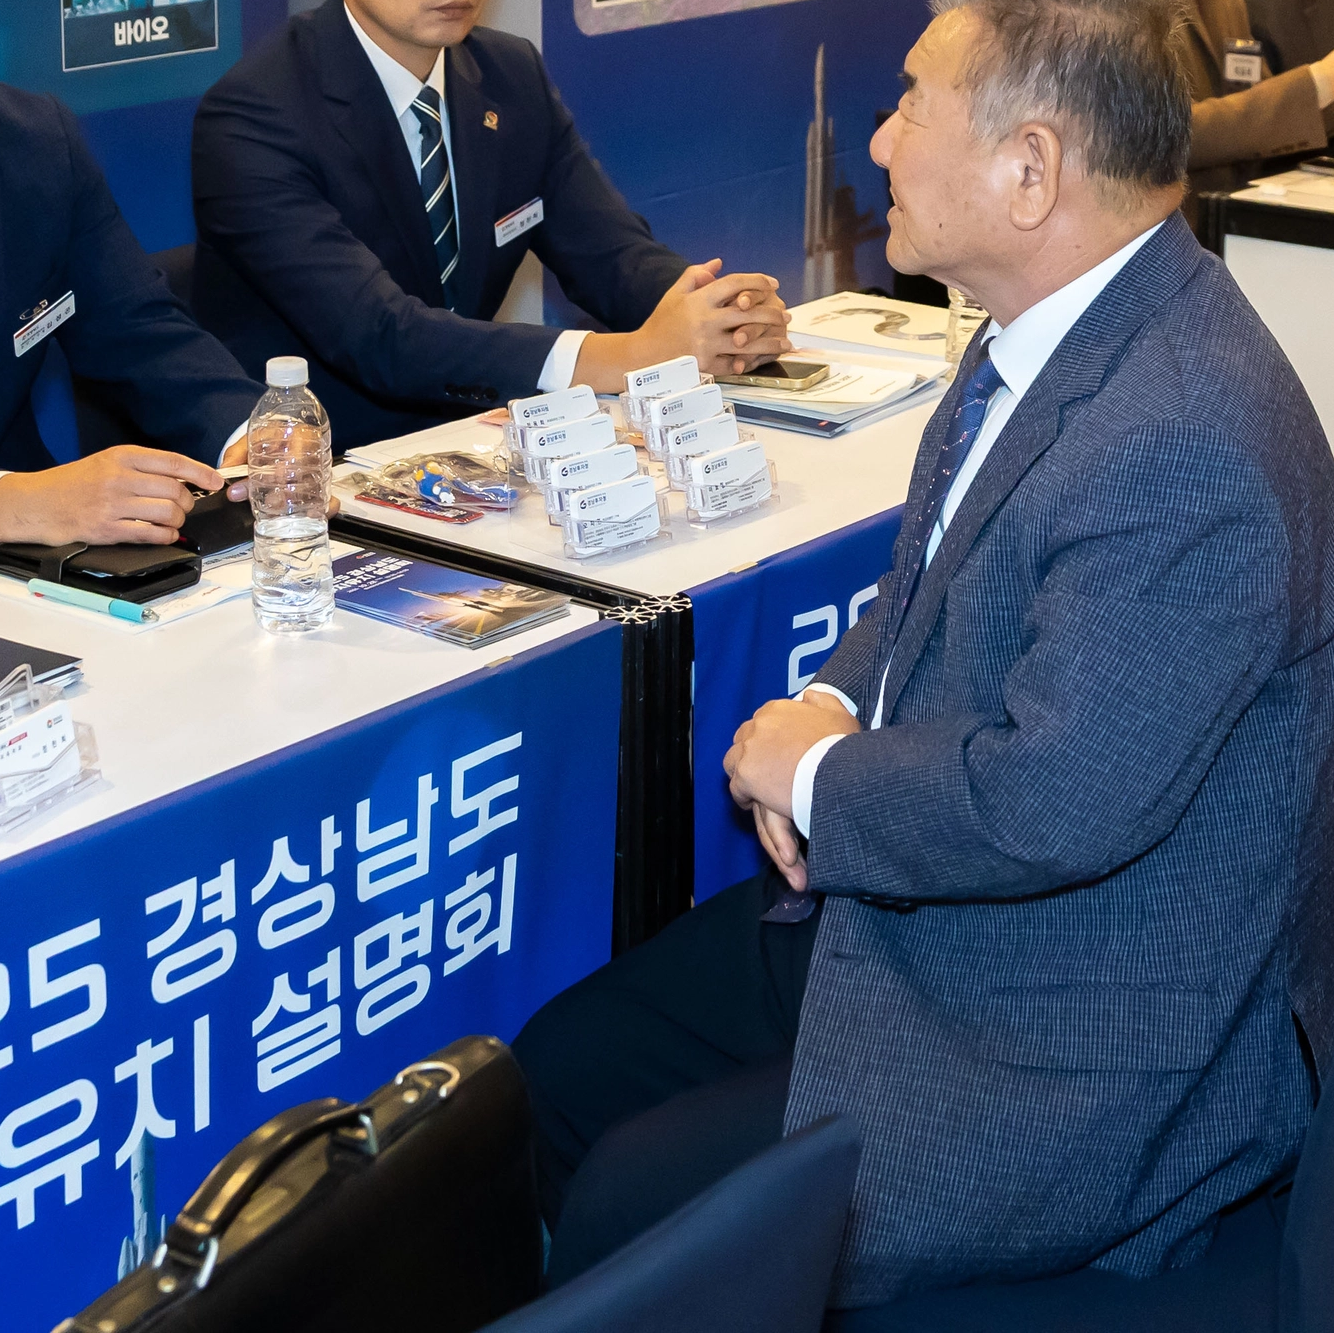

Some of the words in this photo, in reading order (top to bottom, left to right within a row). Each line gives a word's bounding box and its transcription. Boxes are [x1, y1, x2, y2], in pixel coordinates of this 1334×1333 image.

[113, 15, 170, 48] 바이오
[146, 731, 524, 1005] 경상남도
[252, 853, 518, 1095] 설명회
